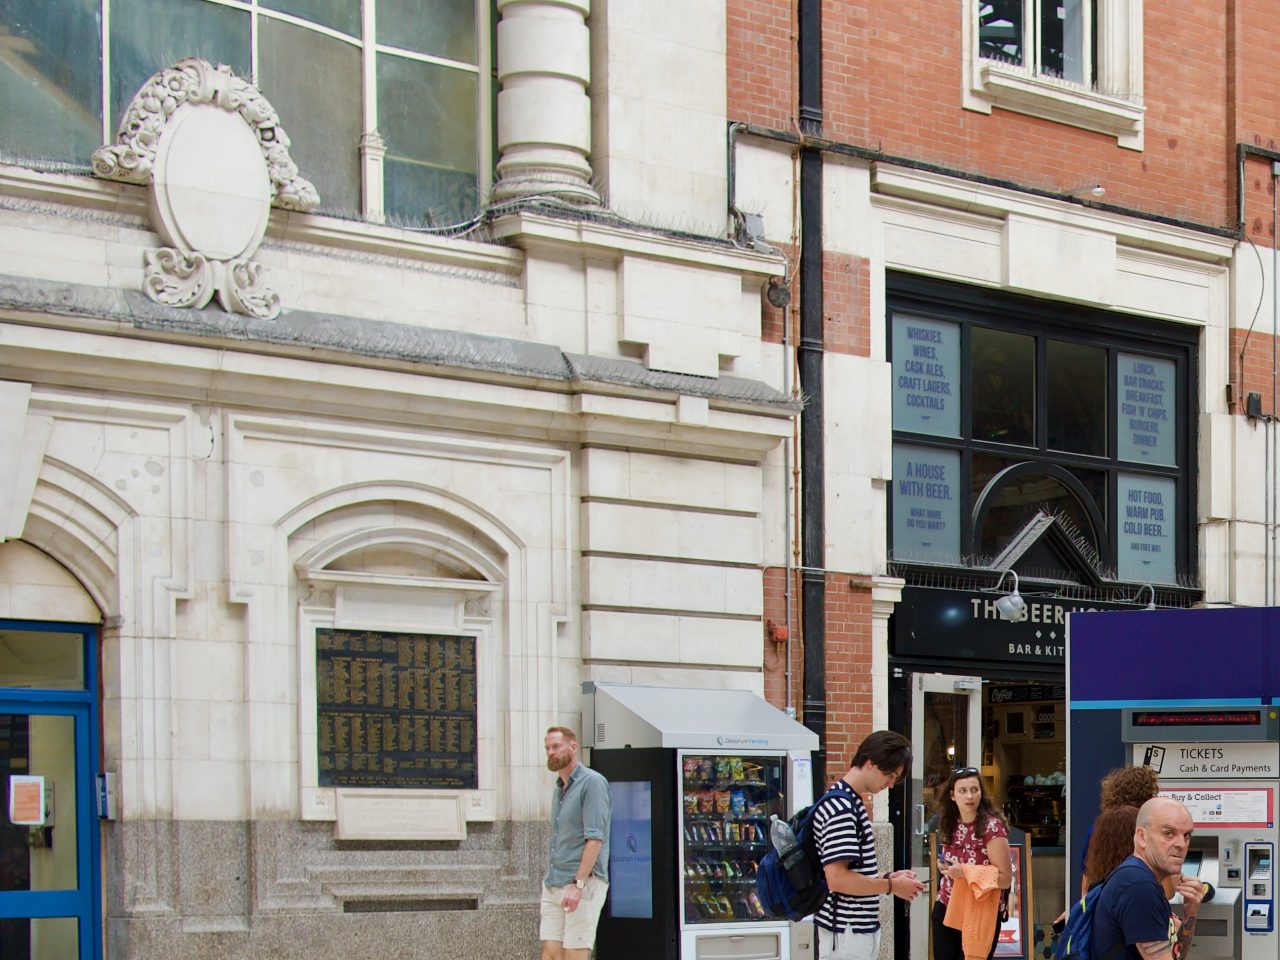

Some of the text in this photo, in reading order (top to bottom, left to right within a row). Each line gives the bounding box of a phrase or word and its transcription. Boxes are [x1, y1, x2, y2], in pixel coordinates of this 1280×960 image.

[907, 326, 944, 345] WHISKIES,
[913, 344, 938, 360] WINES,
[905, 360, 946, 379] CASK ALES,
[898, 375, 952, 396] CRAFT LAGERS,
[1124, 374, 1137, 387] BAR
[906, 393, 945, 411] COCKTAILS
[1121, 403, 1137, 416] FISH
[907, 462, 945, 481] A HOUSE
[899, 479, 952, 501] WITH BEER.
[1128, 488, 1164, 506] HOT FOOD,
[910, 507, 942, 519] WHAT MORE
[1126, 505, 1166, 522] WARM PUB,
[907, 518, 915, 528] DO
[915, 519, 926, 529] YOU
[1124, 520, 1143, 535] COLD
[971, 598, 1065, 625] TH BEER
[1008, 643, 1032, 655] BAR
[1034, 645, 1042, 656] &
[991, 688, 1013, 702] Coffee
[1180, 748, 1224, 759] TICKETS
[1179, 764, 1271, 774] Cash & Card Payments
[1171, 793, 1186, 802] Buy
[1187, 793, 1193, 801] &
[1194, 793, 1222, 801] Collect
